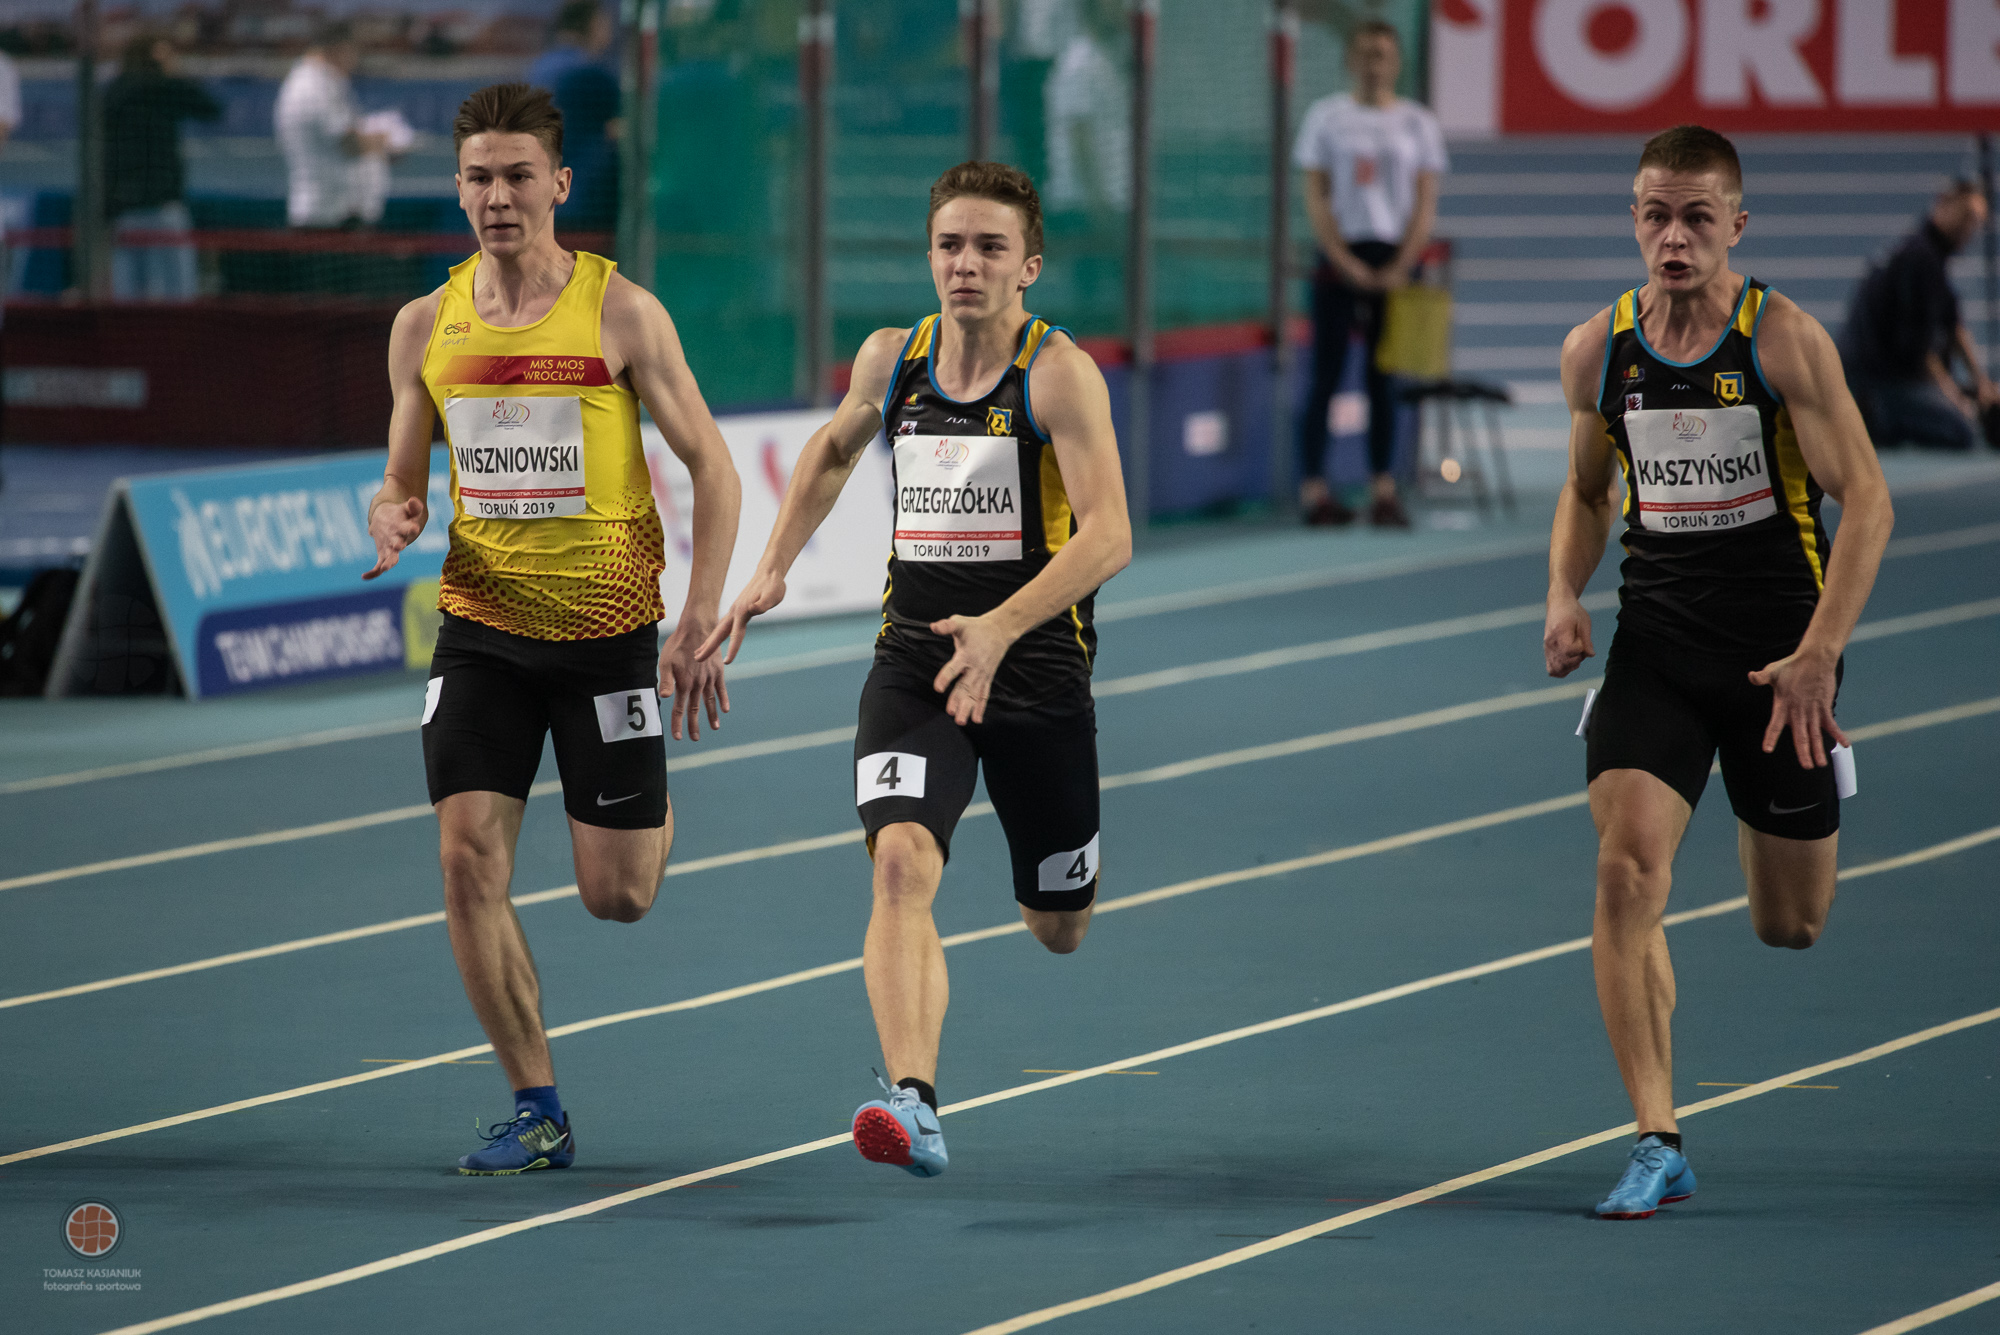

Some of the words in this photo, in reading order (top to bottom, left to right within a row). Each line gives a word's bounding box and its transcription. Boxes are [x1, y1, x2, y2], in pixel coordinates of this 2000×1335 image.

[523, 370, 586, 382] WROCŁAW
[529, 359, 553, 370] MKS
[556, 359, 586, 371] MOS
[455, 446, 579, 474] WISZNIOWSKI
[1637, 451, 1762, 487] KASZYŃSKI
[479, 499, 519, 515] TORUŃ
[522, 501, 556, 515] 2019
[900, 481, 1015, 515] GRZEGRZÓŁKA
[1663, 511, 1709, 529] TORUŃ
[1712, 510, 1746, 527] 2019
[913, 541, 953, 557] TORUŃ
[956, 544, 991, 558] 2019
[626, 694, 647, 732] 5
[875, 756, 902, 790] 4
[1065, 850, 1090, 883] 4
